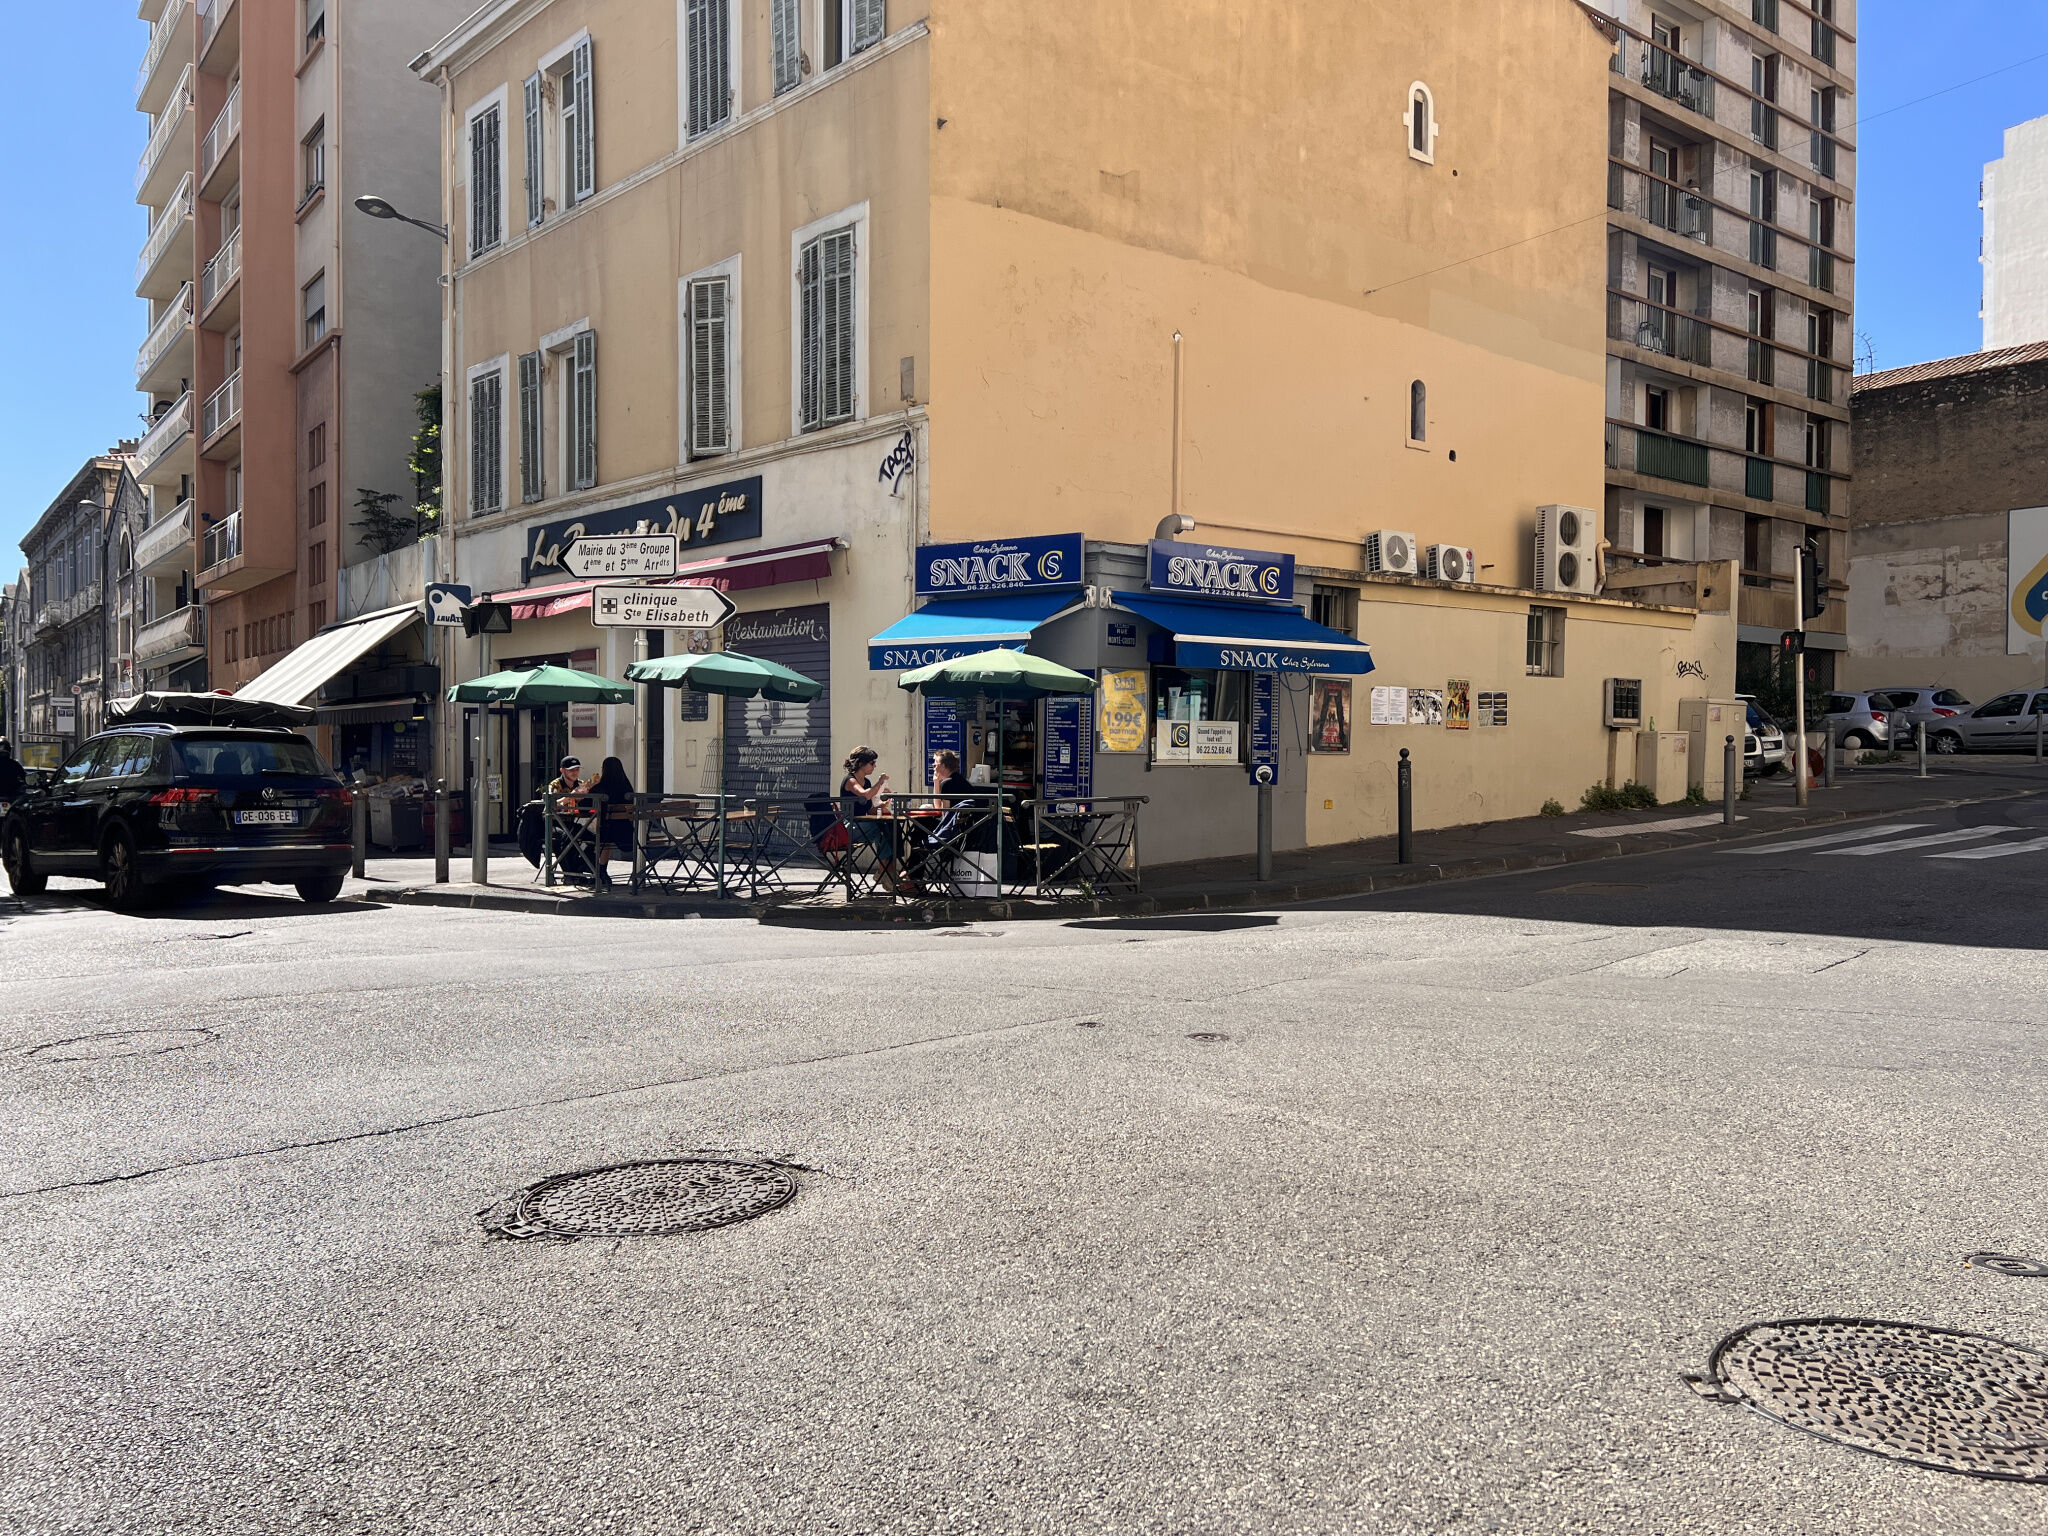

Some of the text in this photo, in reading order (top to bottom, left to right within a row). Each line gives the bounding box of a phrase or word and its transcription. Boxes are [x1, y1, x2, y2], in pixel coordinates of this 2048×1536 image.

[578, 542, 670, 557] Mairie du 3ème Groupe
[583, 558, 670, 572] 4ème et 5ème Arrdts
[930, 552, 1032, 587] SNACK
[1167, 556, 1259, 592] SNACK
[967, 581, 1024, 591] 06.22.526.846
[1200, 588, 1250, 598] 06.22.526.846
[623, 592, 678, 608] clinique
[623, 608, 709, 622] Ste Elisabeth
[726, 616, 824, 646] Restauration
[883, 648, 949, 667] SNACK
[1220, 649, 1279, 668] SNACK
[1105, 711, 1142, 728] 1.99€
[241, 811, 291, 822] GE-036-EE
